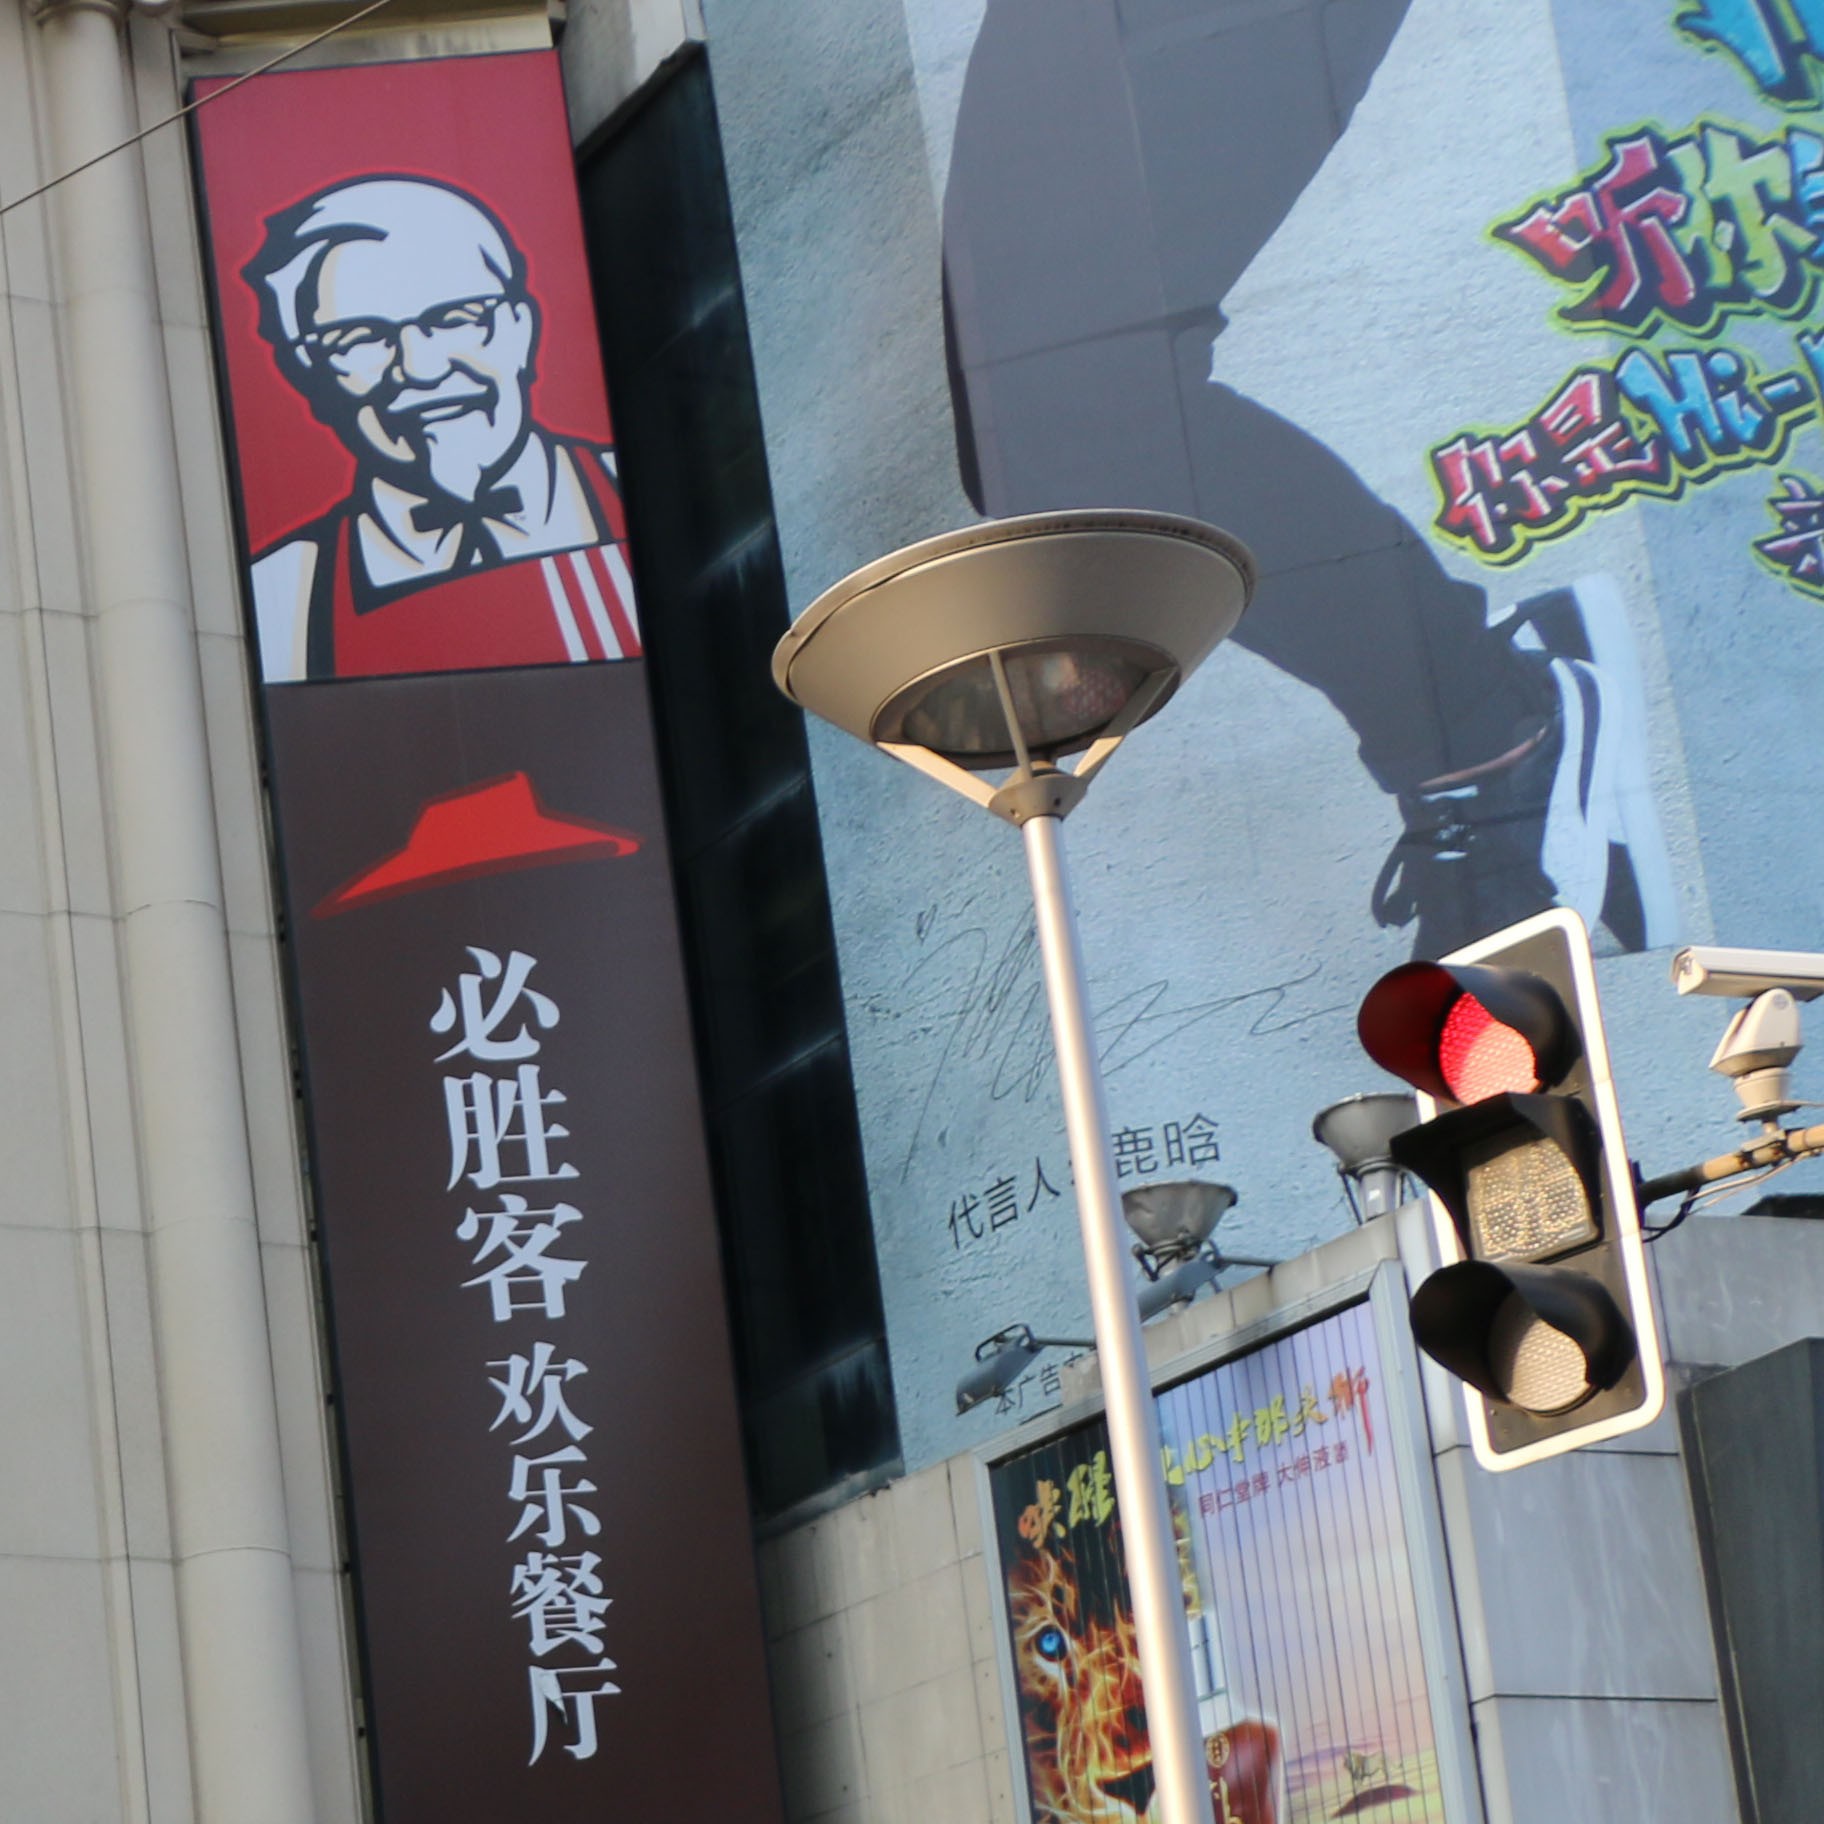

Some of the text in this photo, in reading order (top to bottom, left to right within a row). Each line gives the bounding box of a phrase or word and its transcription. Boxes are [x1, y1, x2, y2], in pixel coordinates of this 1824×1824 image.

[1497, 120, 1824, 335] 听你
[1434, 330, 1824, 552] 你是Hi-
[430, 945, 622, 1766] 必胜客欢乐餐厅
[995, 1352, 1087, 1416] 本广告
